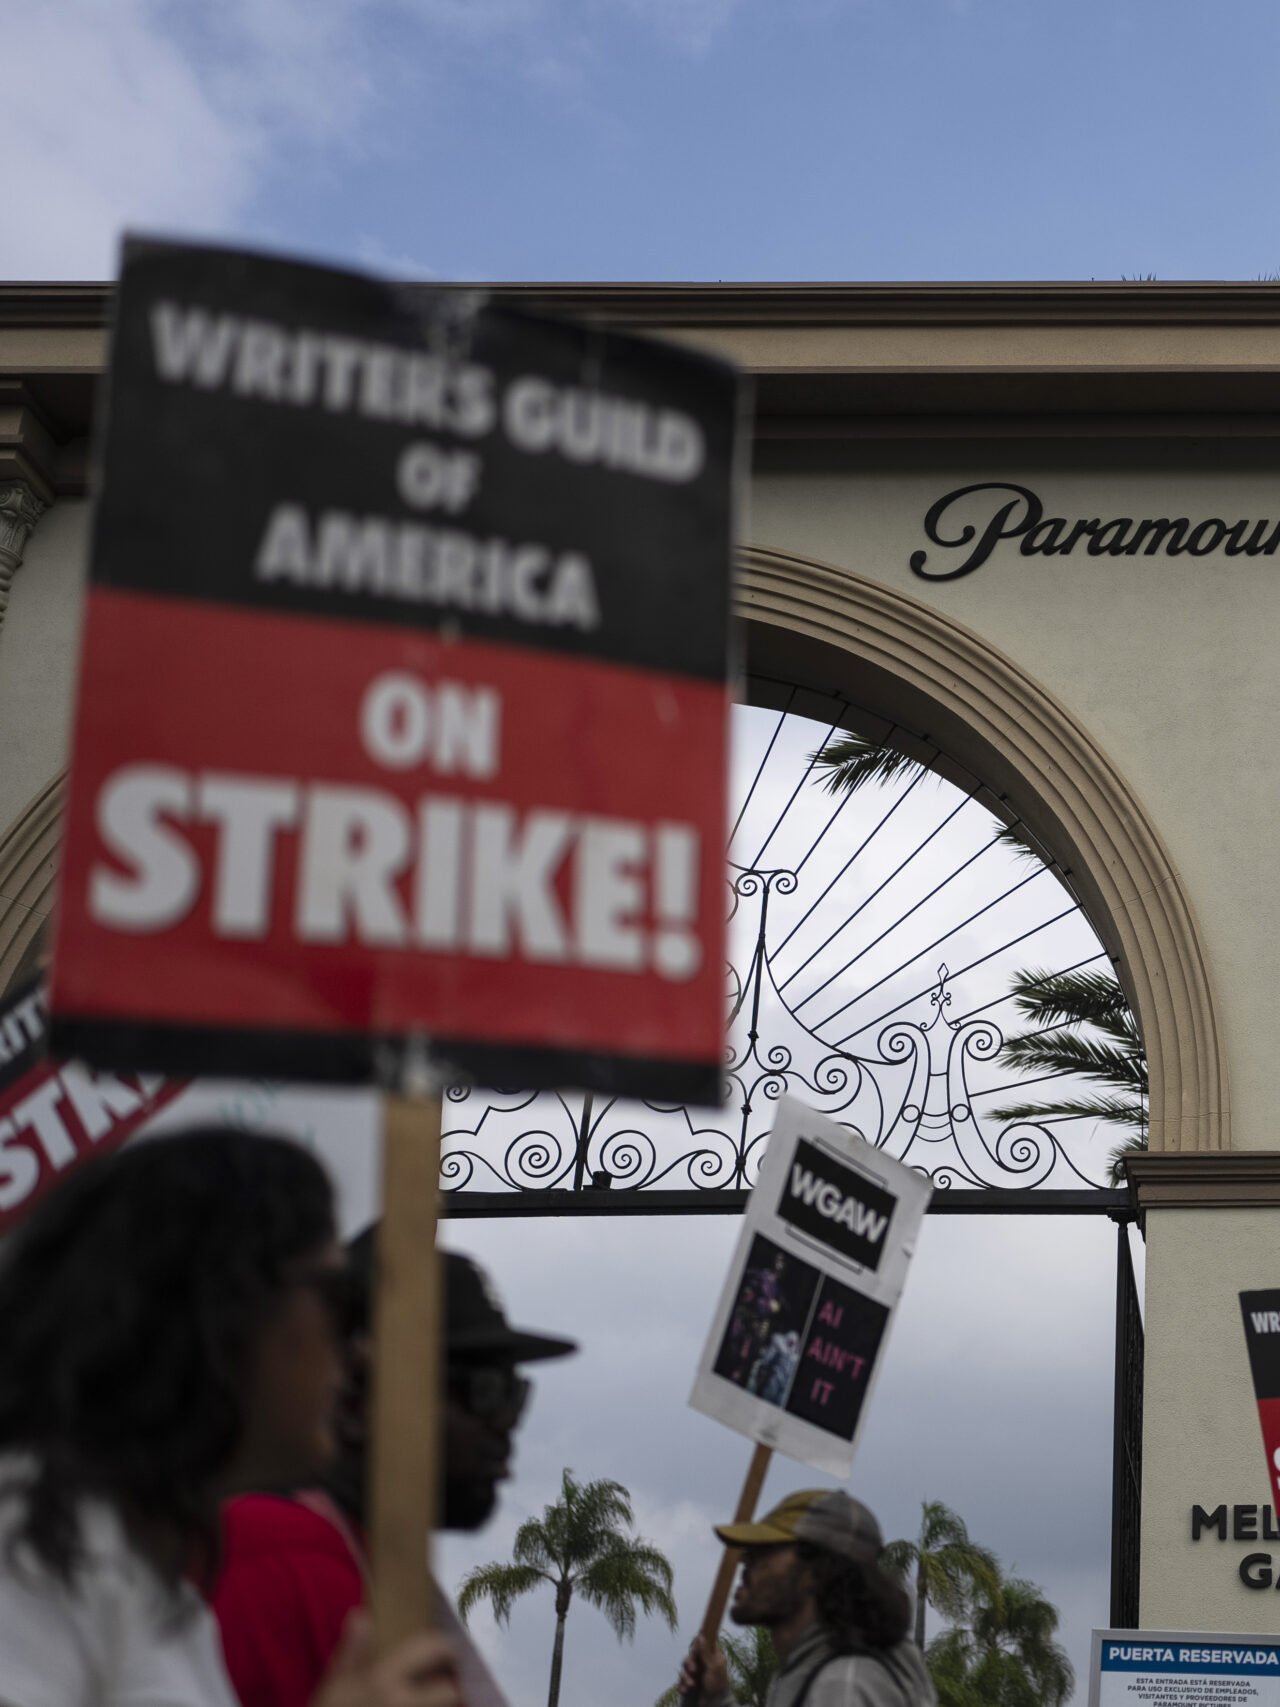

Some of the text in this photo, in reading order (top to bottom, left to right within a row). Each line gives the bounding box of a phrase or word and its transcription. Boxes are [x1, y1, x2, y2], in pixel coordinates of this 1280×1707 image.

[151, 303, 705, 483] WRITERS GUILD
[398, 442, 483, 512] OF
[256, 506, 598, 632] AMERICA
[360, 672, 500, 777] ON
[89, 762, 703, 982] STRIKE!
[791, 1163, 888, 1245] WGAW
[818, 1301, 844, 1329] AI
[807, 1336, 867, 1380] AIN'T
[810, 1377, 835, 1406] IT
[1109, 1647, 1279, 1665] PUERTA RESERVADA
[1138, 1693, 1179, 1701] VISITANTES
[1186, 1694, 1237, 1702] PROVEEDORES
[1155, 1678, 1188, 1686] ENTRADA
[1164, 1686, 1202, 1694] EXCLUSIVO
[1215, 1688, 1259, 1696] EMPLEADOS,
